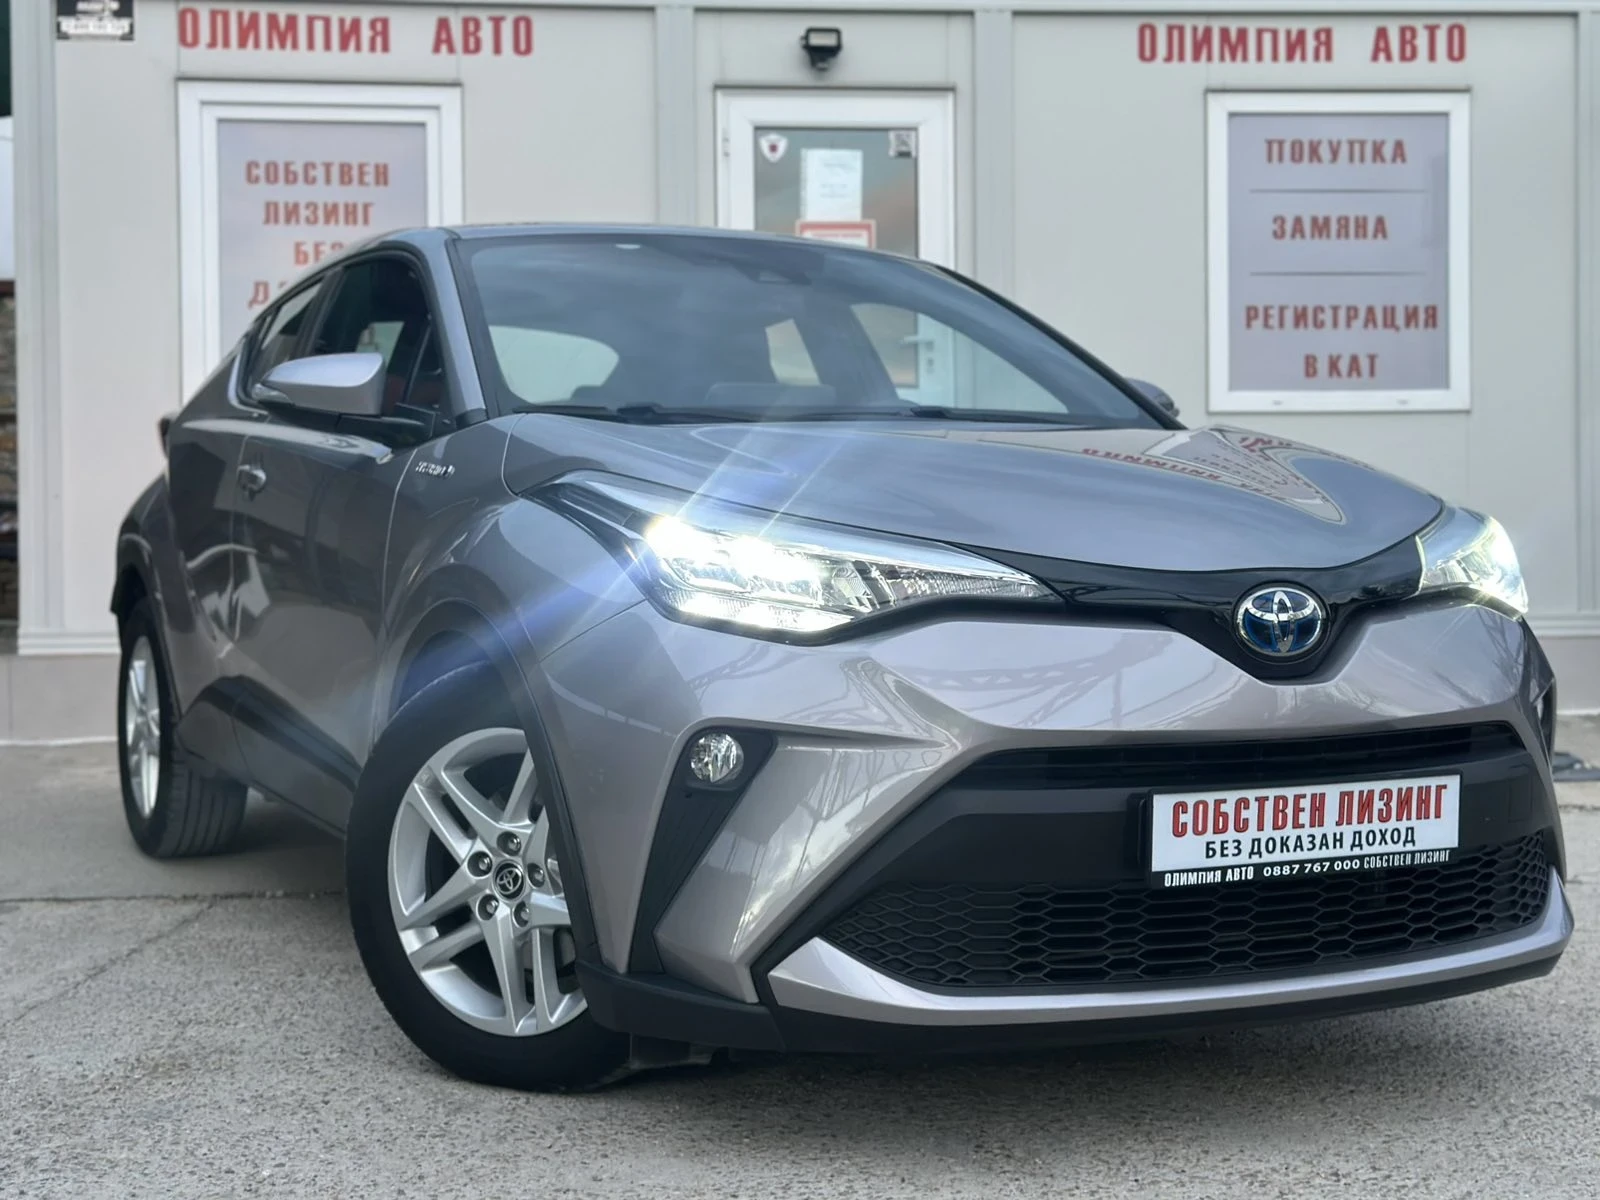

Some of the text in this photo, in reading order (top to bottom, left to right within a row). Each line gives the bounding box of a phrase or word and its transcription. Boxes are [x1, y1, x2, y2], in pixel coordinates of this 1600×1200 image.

[178, 7, 391, 53] ОЛИМПИЯ
[431, 15, 534, 56] АВТО
[1137, 23, 1468, 63] ОЛИМПИЯ АВТО
[1264, 138, 1408, 164] ПОКУПКА
[245, 160, 390, 187] СОБСТВЕН
[263, 201, 375, 227] ЛИЗИНГ
[1272, 215, 1389, 240] ЗАМЯНА
[1244, 304, 1439, 332] РЕГИСТРАЦИЯ
[1304, 353, 1379, 379] В КАТ
[1172, 784, 1448, 838] СОБСТВЕН ЛИЗИНГ
[1205, 827, 1416, 859] БЕЗ ДОКАЗАН ДОХОД
[1164, 850, 1450, 887] ОЛИМПИЯ АВТО 0887 767 000 СОБСТВЕН ЛИЗИНГ
